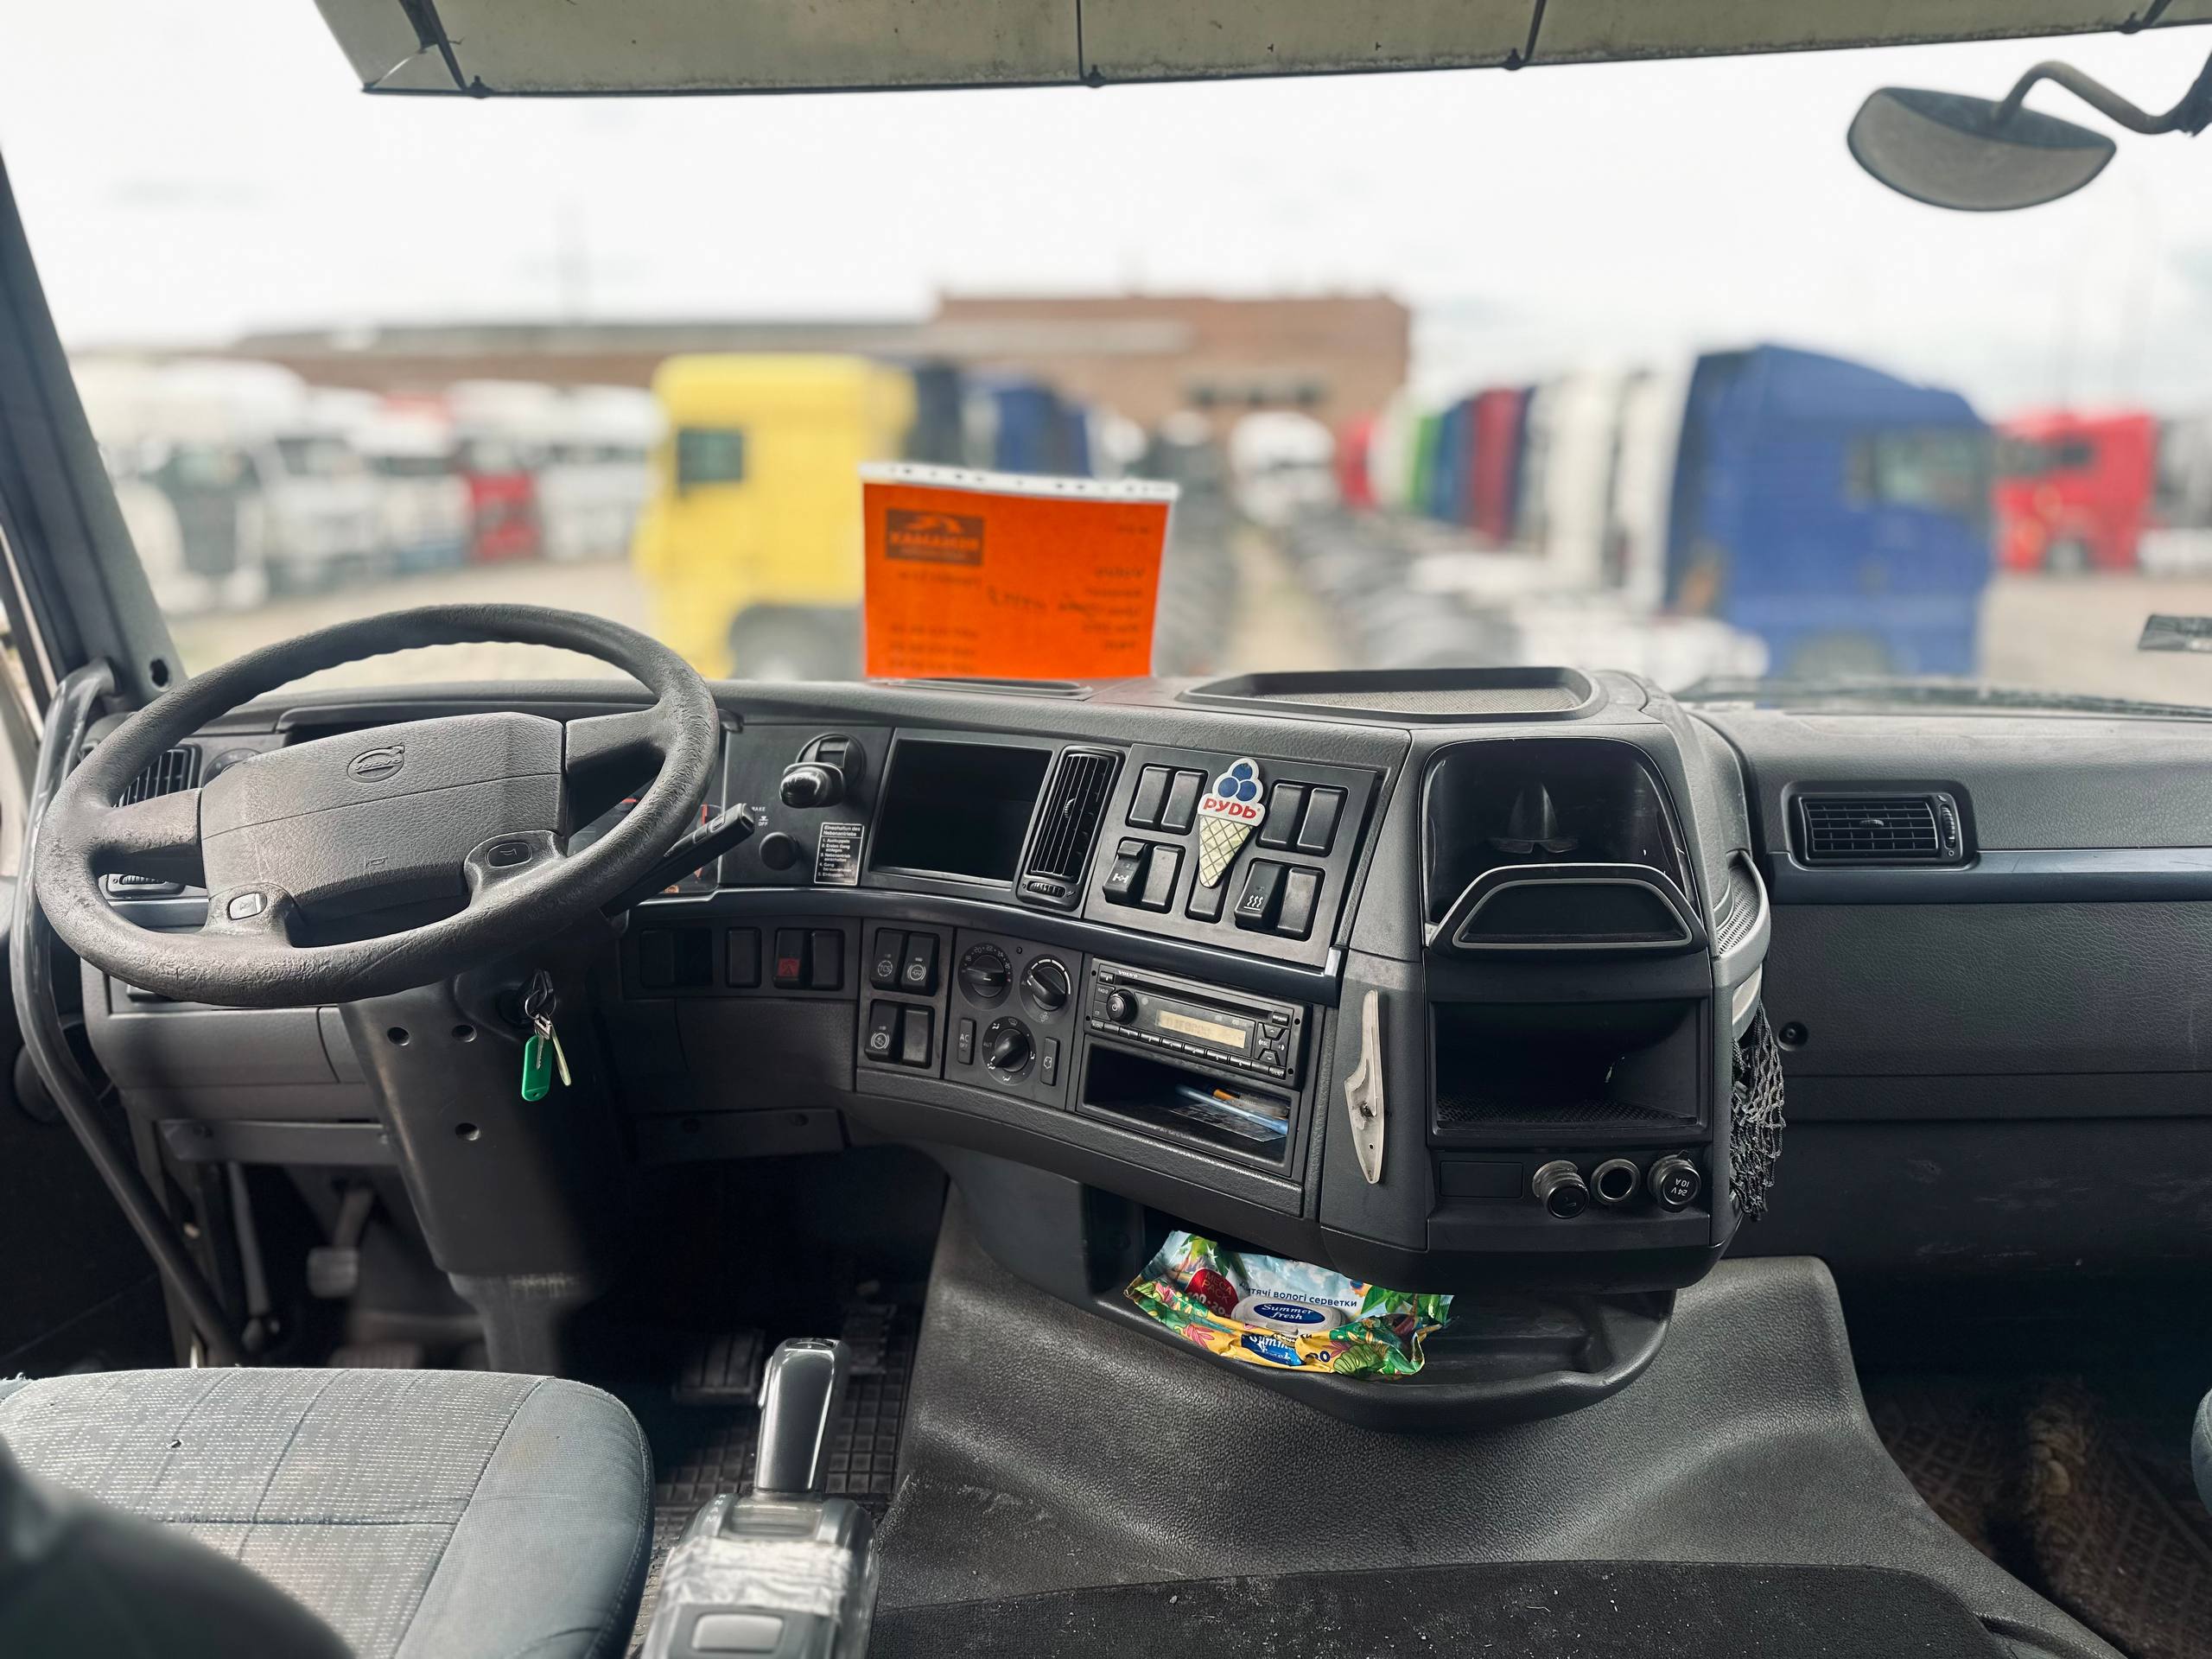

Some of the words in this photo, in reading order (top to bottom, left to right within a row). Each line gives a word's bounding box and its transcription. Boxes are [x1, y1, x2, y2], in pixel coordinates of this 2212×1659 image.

[1118, 969, 1138, 978] VOLVO
[959, 1033, 969, 1042] AC
[1205, 1272, 1231, 1295] MEGA
[1201, 1279, 1230, 1304] PACK
[1274, 1291, 1306, 1302] вологі
[1309, 1295, 1357, 1307] серветки
[1262, 1304, 1314, 1314] Summer
[1270, 1312, 1303, 1320] fresh
